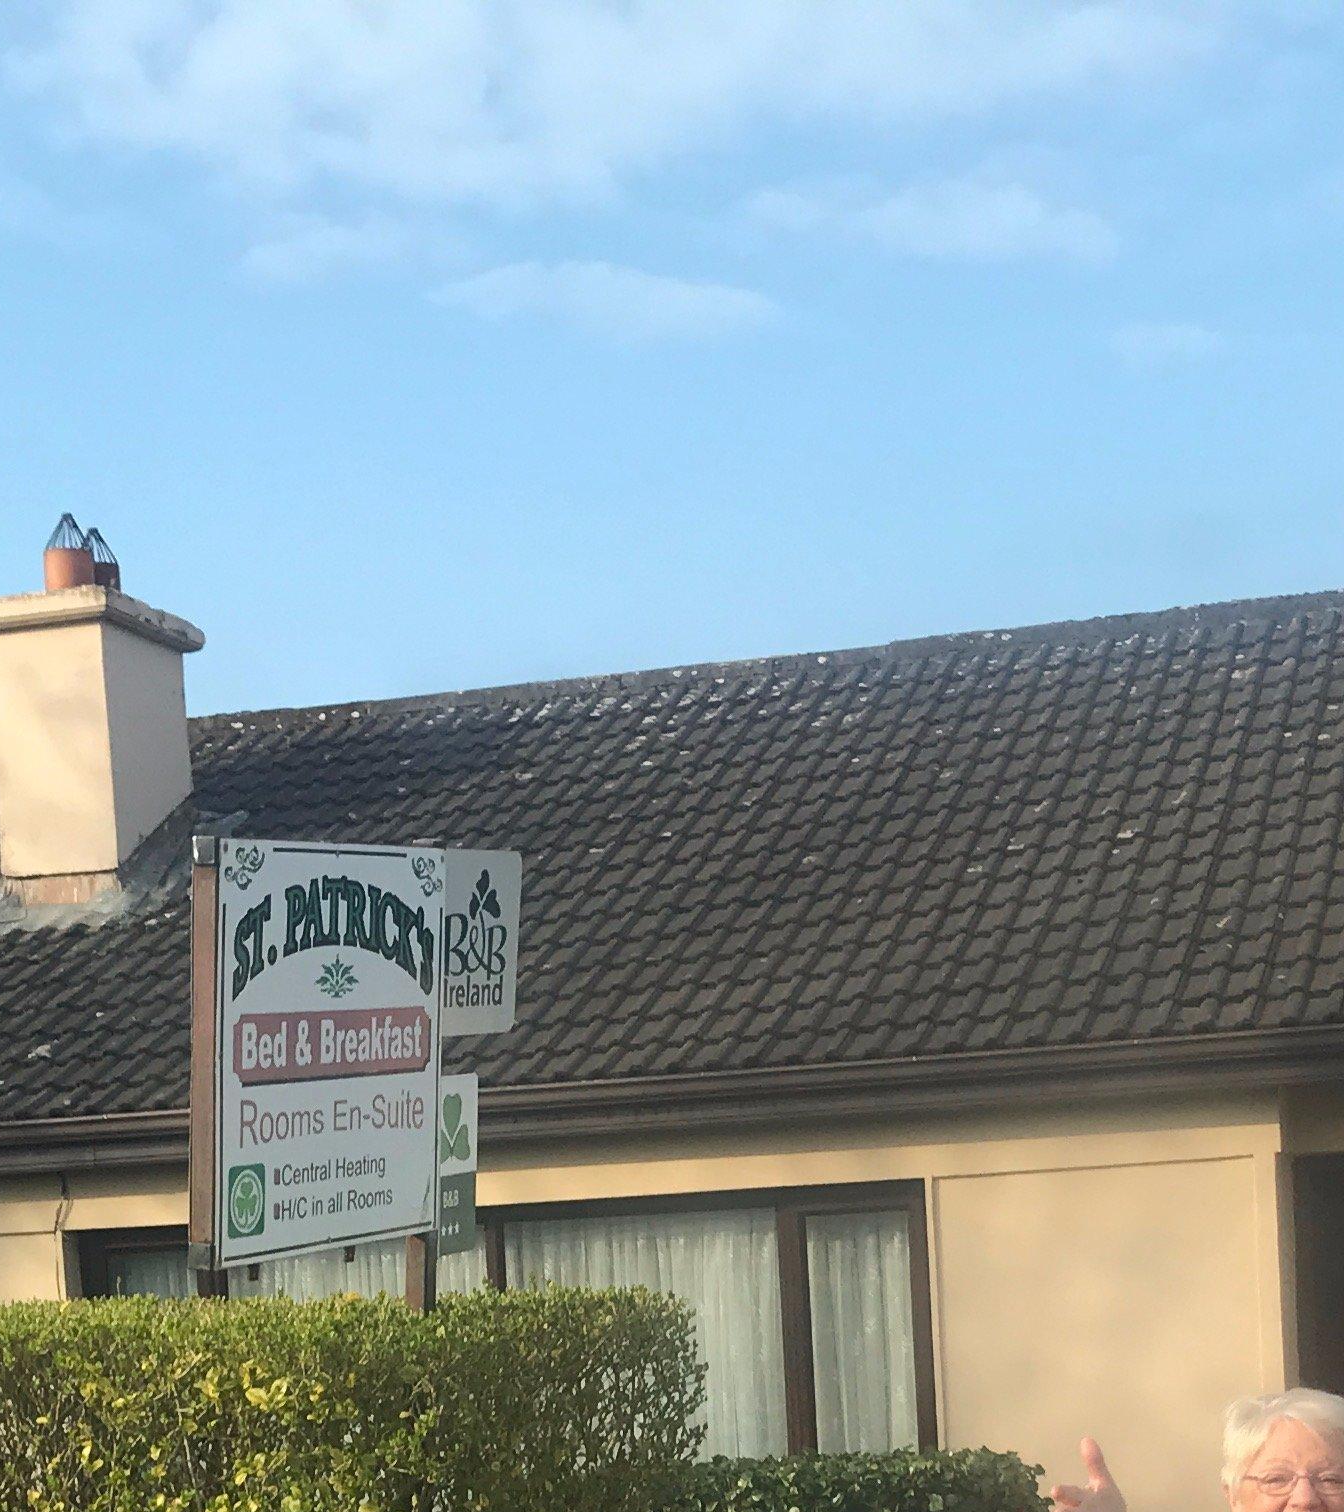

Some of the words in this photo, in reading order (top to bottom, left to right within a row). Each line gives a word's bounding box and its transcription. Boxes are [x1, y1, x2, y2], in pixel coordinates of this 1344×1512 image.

[232, 893, 277, 1001] ST.
[443, 974, 504, 1008] Ireland
[241, 1021, 287, 1070] Bed
[295, 1019, 312, 1066] &
[320, 1015, 422, 1065] Breakfast
[239, 1099, 325, 1149] Rooms
[333, 1089, 425, 1131] En-Suite
[281, 1159, 331, 1187] Central
[335, 1154, 386, 1178] Heating
[281, 1196, 308, 1222] H/C
[311, 1197, 324, 1216] in
[327, 1191, 343, 1213] all
[347, 1187, 393, 1211] Rooms
